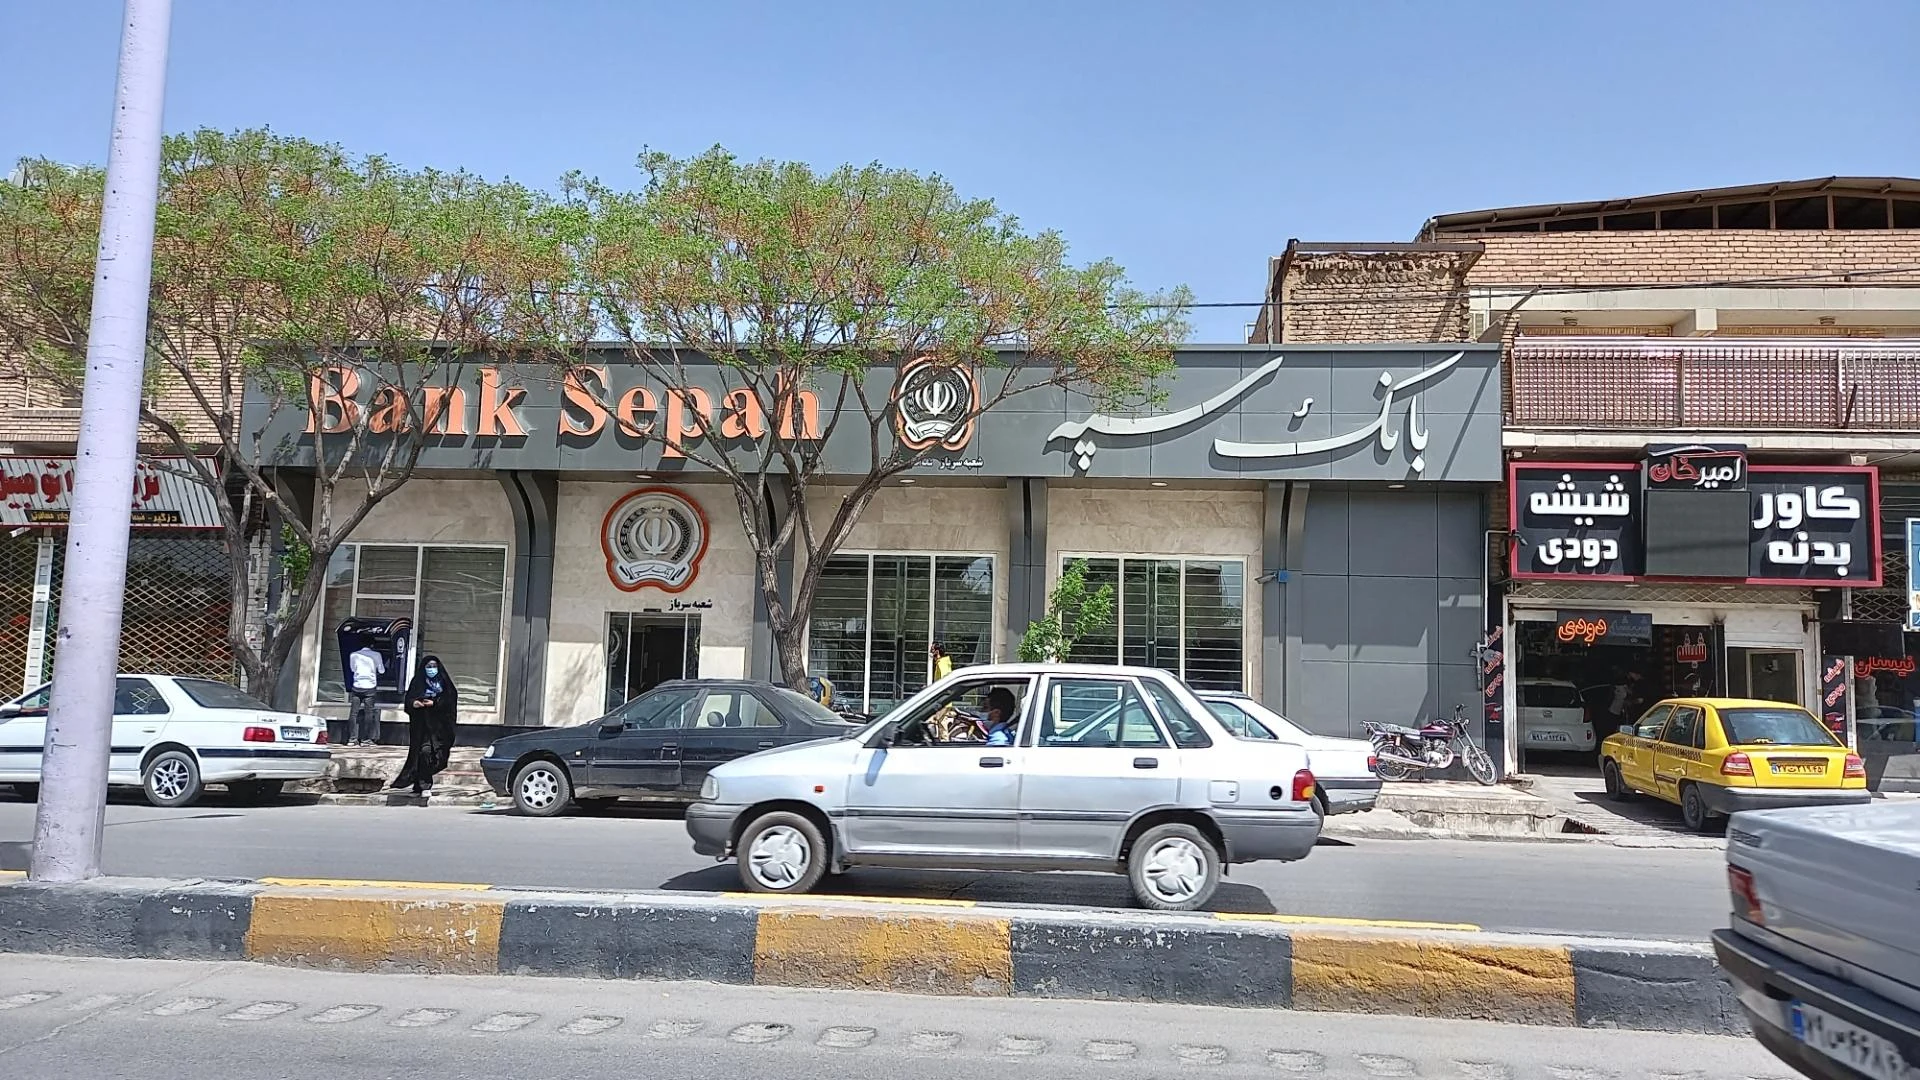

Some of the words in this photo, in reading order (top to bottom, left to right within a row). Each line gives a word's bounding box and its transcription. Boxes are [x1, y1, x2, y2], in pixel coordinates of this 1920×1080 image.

[301, 366, 530, 436] Bank
[558, 363, 823, 459] Sepah
[1047, 355, 1284, 471] سپه
[1214, 351, 1465, 473] بانک
[939, 456, 963, 470] سرباز
[964, 457, 983, 469] شعبه
[1530, 474, 1630, 526] شیشه
[1752, 486, 1861, 530] کاور
[1538, 538, 1619, 568] دودی
[1768, 532, 1851, 578] بدنه
[668, 598, 691, 611] سرباز
[692, 598, 713, 611] شعبه
[1558, 617, 1607, 643] دودی
[1855, 656, 1916, 679] نیسان
